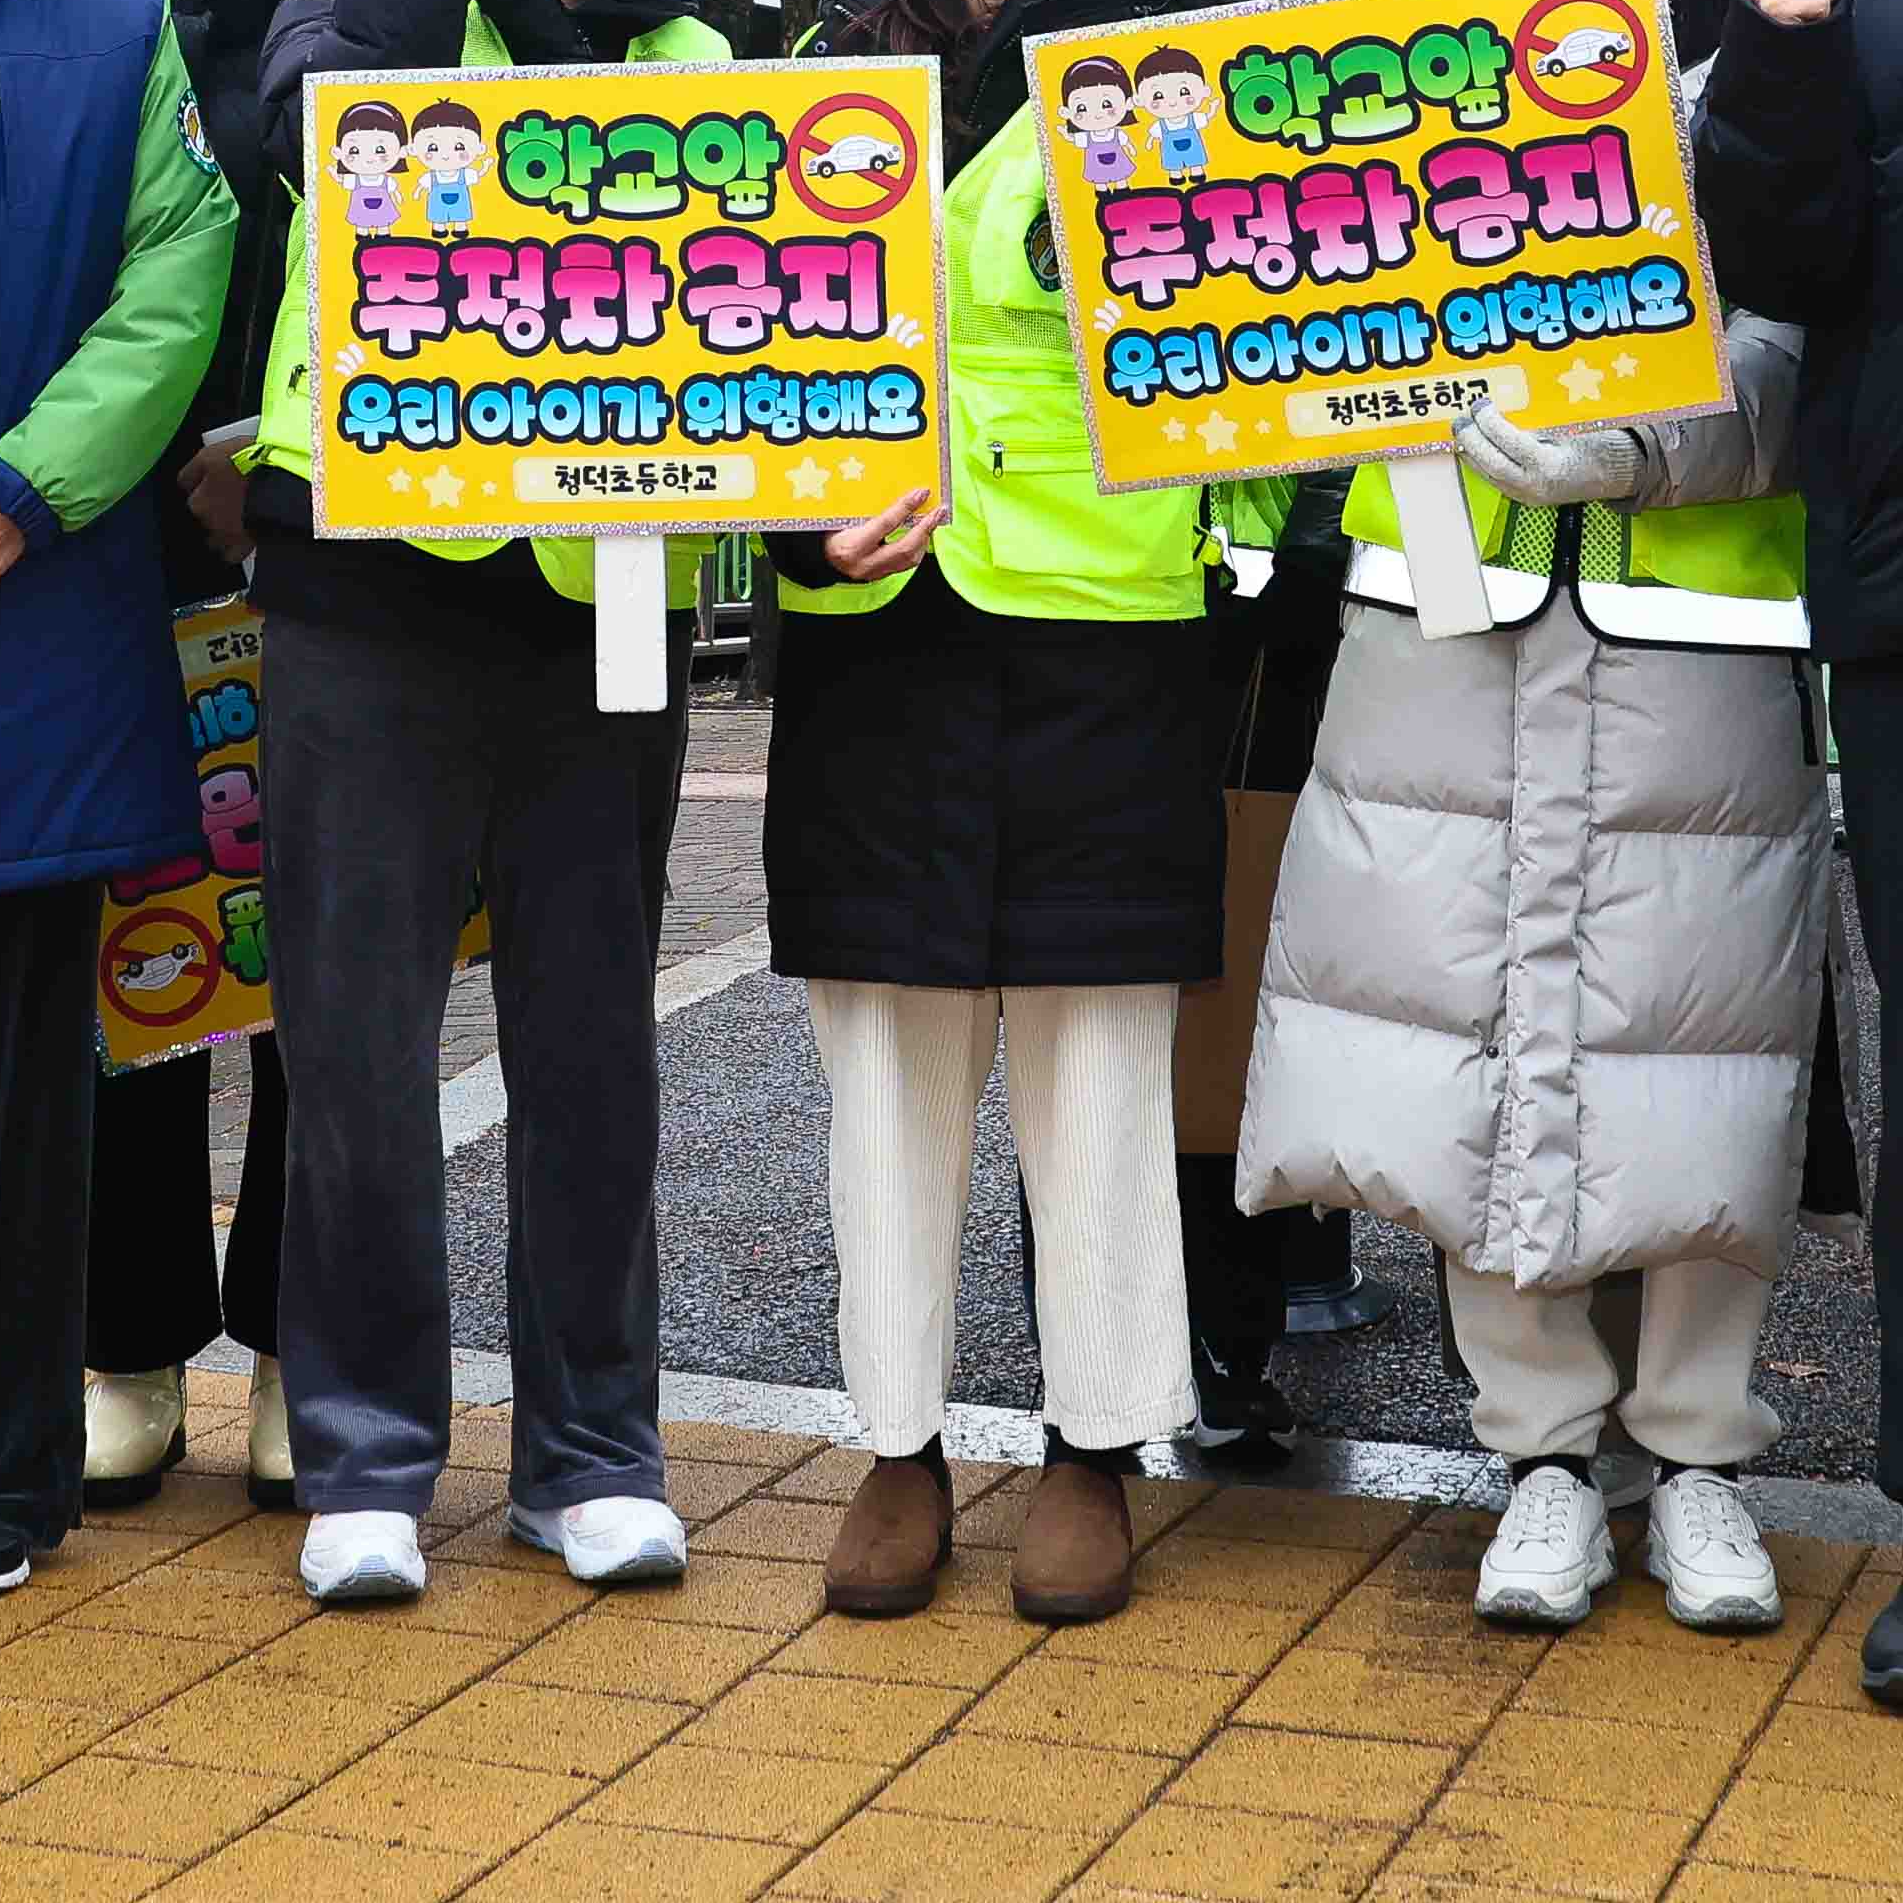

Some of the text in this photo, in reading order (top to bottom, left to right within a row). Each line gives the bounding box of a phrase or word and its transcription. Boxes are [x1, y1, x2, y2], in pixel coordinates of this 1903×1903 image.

[1219, 17, 1515, 155] 학교앞
[498, 111, 787, 224] 학교앞
[1096, 158, 1420, 310] 주정차
[1419, 125, 1643, 266] 금지
[352, 234, 670, 358] 주정차
[679, 228, 889, 354] 금지
[1103, 256, 1693, 406] 우리 아이가 위험해요
[338, 364, 927, 453] 우리 아이가 위험해요
[555, 462, 718, 496] 청덕초등학교
